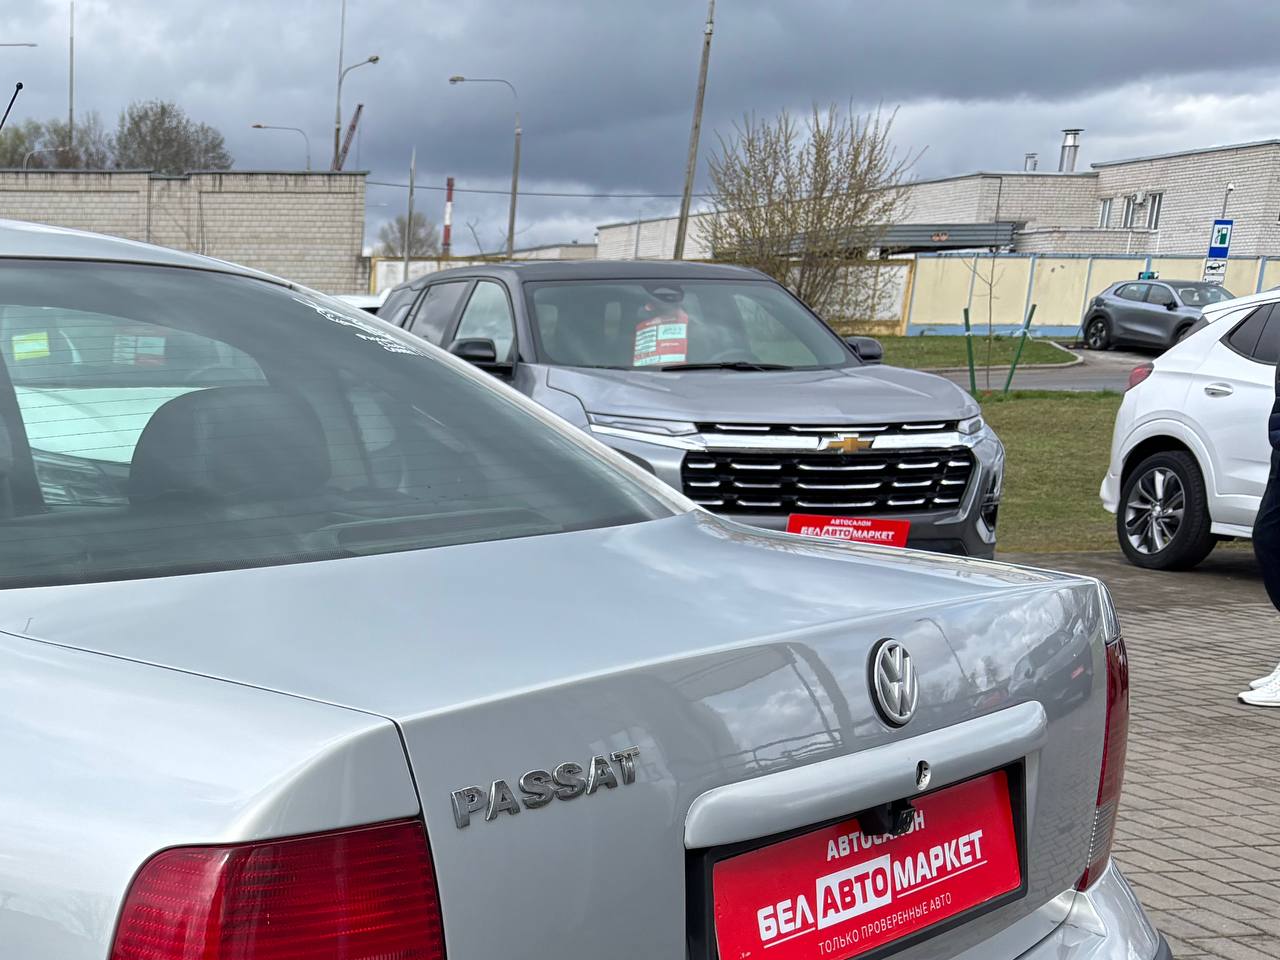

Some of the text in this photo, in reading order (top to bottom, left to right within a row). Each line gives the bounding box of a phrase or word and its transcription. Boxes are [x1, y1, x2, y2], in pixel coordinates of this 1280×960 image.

[450, 745, 640, 829] PASSAT
[826, 810, 925, 862] АВТОН
[818, 892, 952, 956] ТОЛЬКО ПРОВЕРЕННЫЕ АВТО
